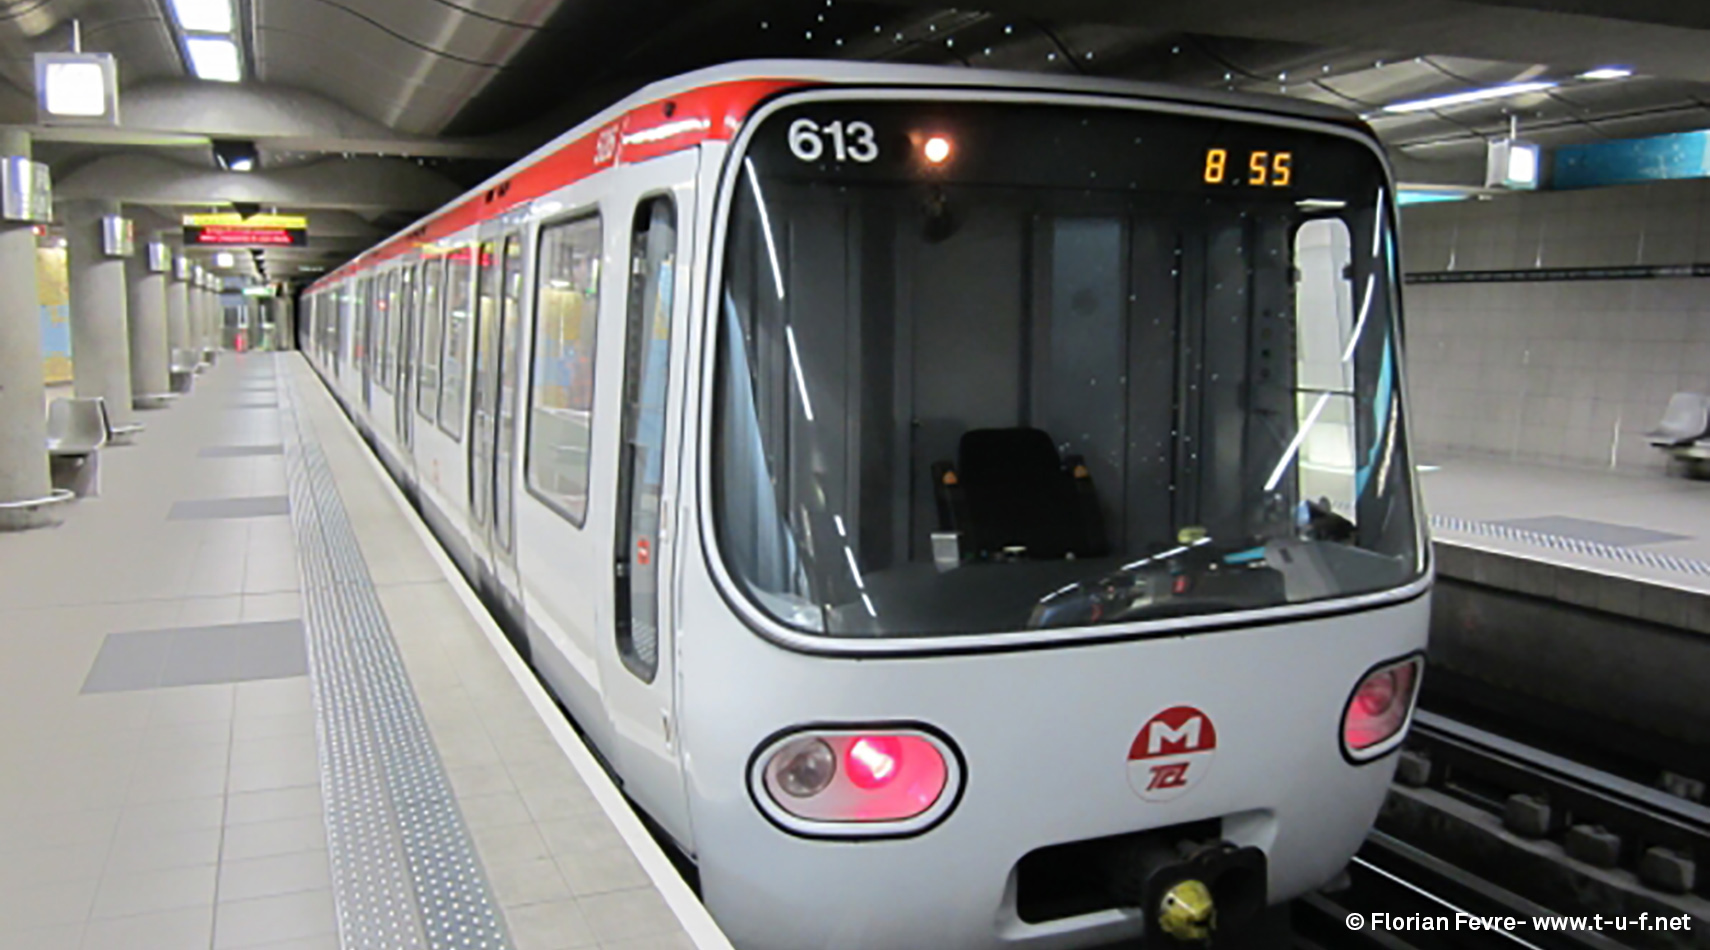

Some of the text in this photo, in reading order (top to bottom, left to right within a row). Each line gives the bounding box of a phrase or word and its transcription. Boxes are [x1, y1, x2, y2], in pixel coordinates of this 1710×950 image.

[788, 118, 878, 162] 613
[1204, 149, 1292, 186] 8 55
[1147, 716, 1202, 755] M
